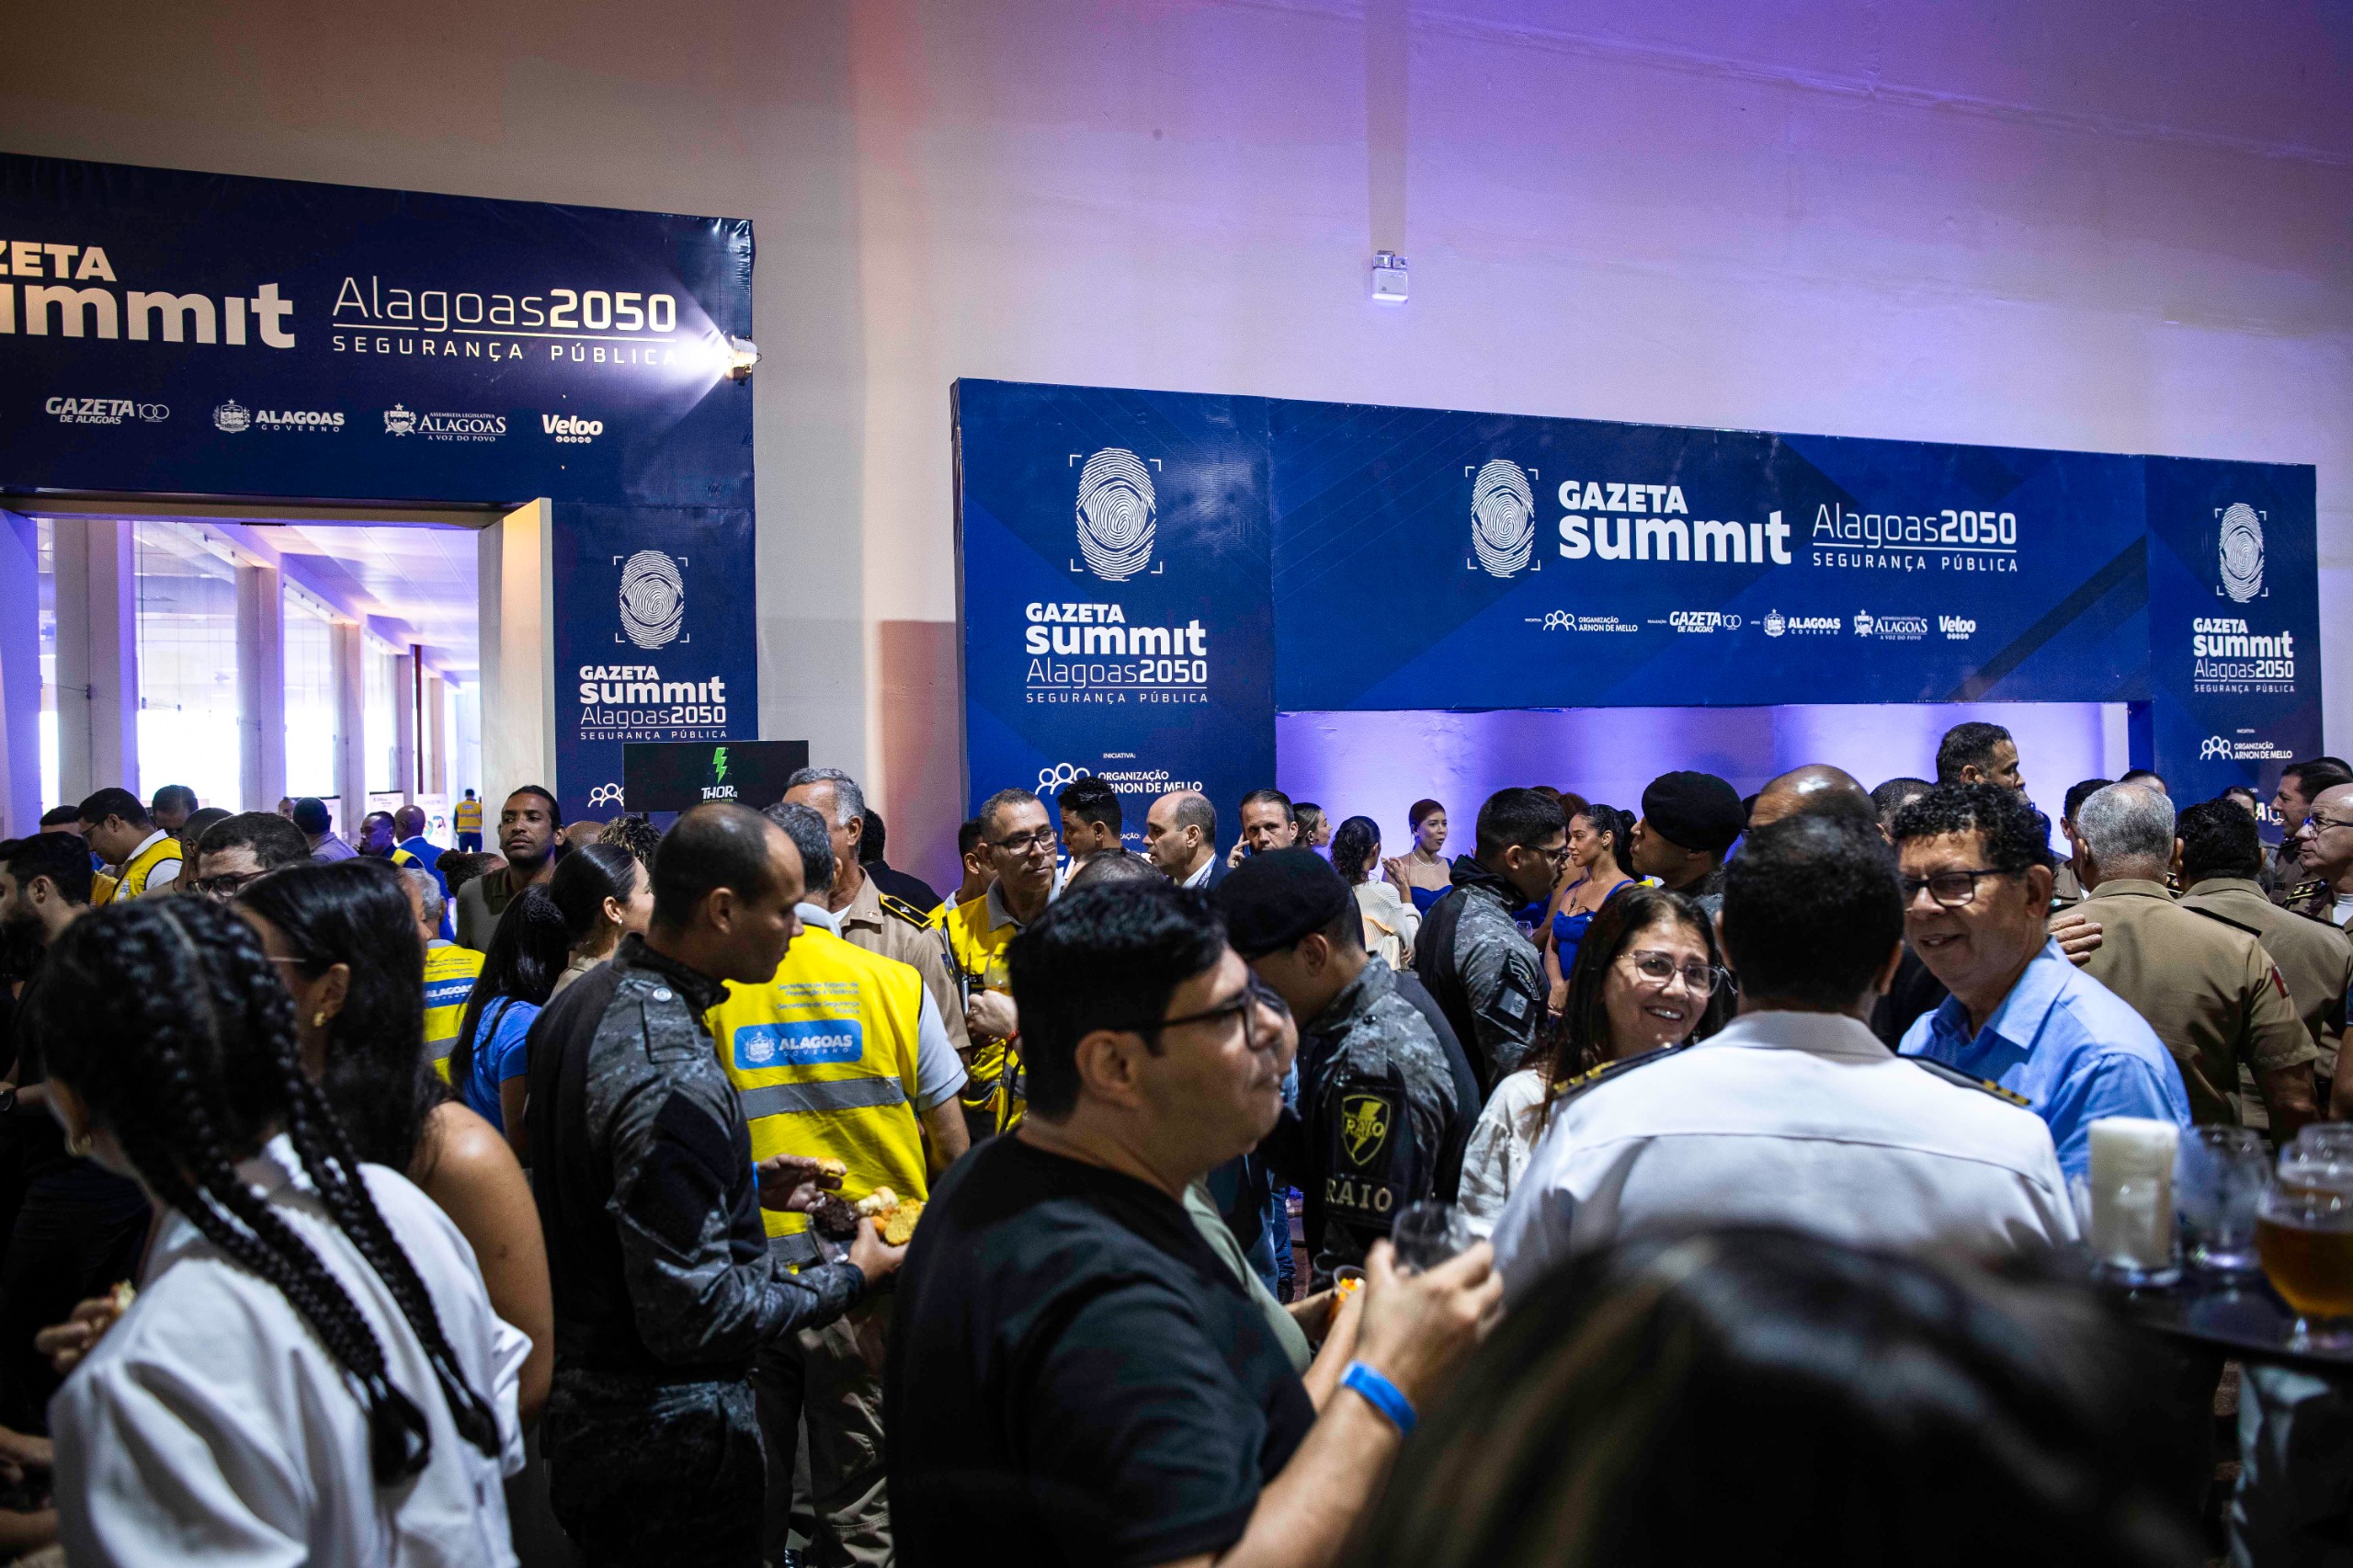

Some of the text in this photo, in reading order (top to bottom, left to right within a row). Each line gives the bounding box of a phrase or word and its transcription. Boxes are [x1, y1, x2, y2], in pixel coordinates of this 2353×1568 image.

[0, 240, 117, 282] ETA
[333, 335, 678, 367] SEGURANÇA PÚBLICA
[45, 397, 135, 416] GAZETA
[60, 415, 121, 424] DE ALAGOAS
[255, 410, 346, 426] ALAGOAS
[417, 415, 506, 433] ALAGOAS
[542, 414, 603, 435] Veloo
[261, 425, 341, 433] GOVERNO
[1558, 481, 1688, 514] GAZETA
[1559, 510, 1792, 564] summit
[1813, 553, 2018, 574] SEGURANÇA PÚBLICA
[1026, 603, 1125, 623] GAZETA
[1578, 616, 1620, 625] ORGANIZAÇÃO
[1669, 610, 1722, 627] GAZETA
[1616, 624, 1638, 632] MELLO
[1788, 617, 1841, 630] ALAGOAS
[1874, 617, 1928, 632] ALAGOAS
[1938, 615, 1977, 633] Veloo
[2193, 617, 2248, 634] GAZETA
[1026, 619, 1207, 656] summit
[2193, 631, 2294, 658] summit
[579, 665, 660, 680] GAZETA
[580, 676, 725, 704] summit
[2194, 682, 2295, 694] SEGURANÇA PÚBLICA
[1027, 691, 1208, 704] SEGURANÇA PÚBLICA
[581, 729, 727, 740] SEGURANÇA PÚBLICA
[2234, 741, 2274, 750] ORGANIZAÇÃO
[2234, 750, 2293, 759] ARNON DE MELLO
[1097, 769, 1169, 782] ORGANIZAÇÃO
[1146, 783, 1161, 793] DE
[778, 1034, 853, 1051] ALAGOAS
[1324, 1177, 1392, 1212] RAIO
